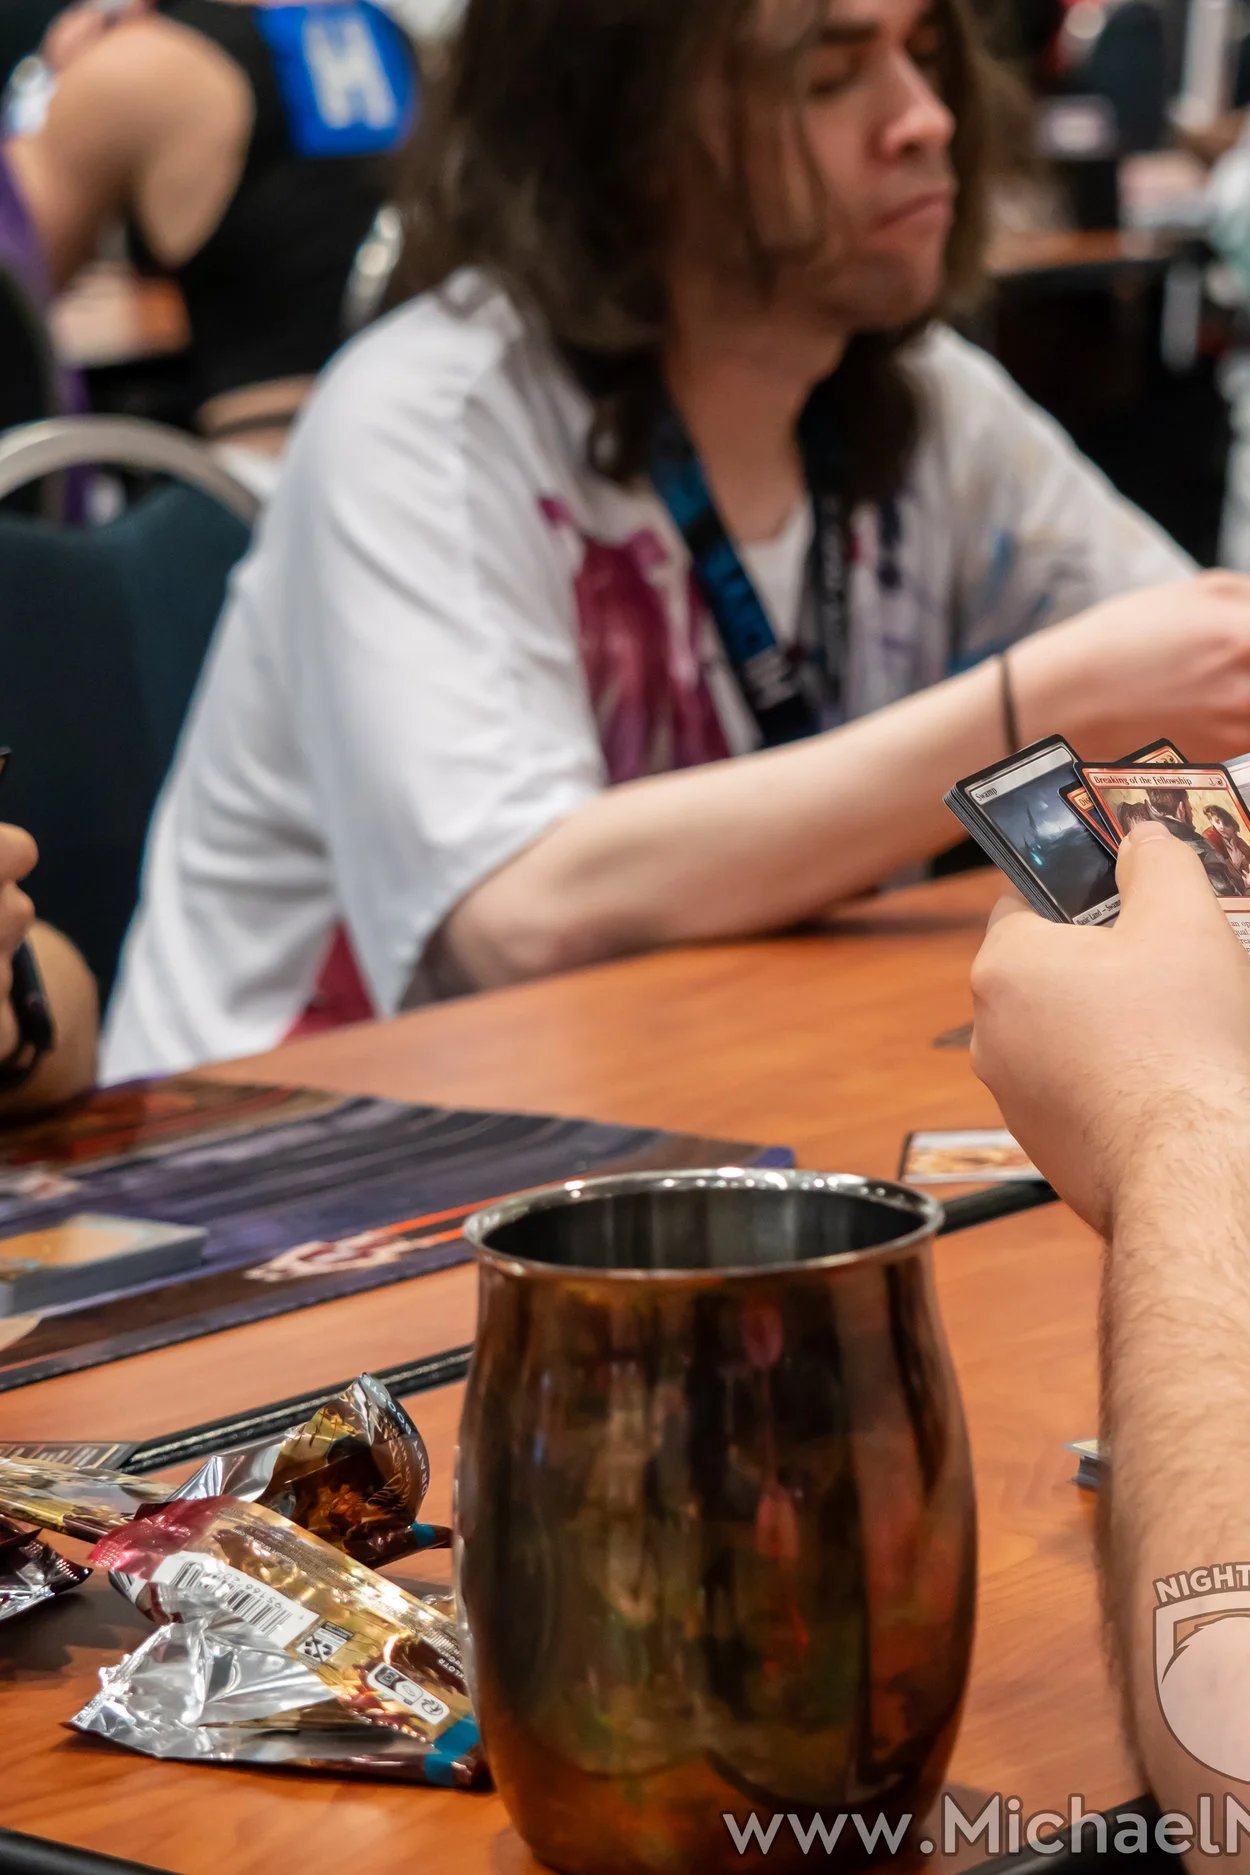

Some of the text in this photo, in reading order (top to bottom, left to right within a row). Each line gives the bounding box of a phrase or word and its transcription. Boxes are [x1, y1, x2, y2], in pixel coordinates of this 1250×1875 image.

[1094, 776, 1127, 785] Breaking
[1129, 776, 1137, 784] of
[1139, 776, 1151, 784] the
[1152, 777, 1192, 786] Fellowship
[974, 787, 998, 801] Swamp
[1088, 908, 1103, 920] Land
[1105, 899, 1121, 912] Swam
[363, 1375, 412, 1436] BOOSTE
[411, 1440, 428, 1496] DRAFT
[245, 1583, 282, 1610] 95166
[438, 1658, 465, 1680] xLOTR
